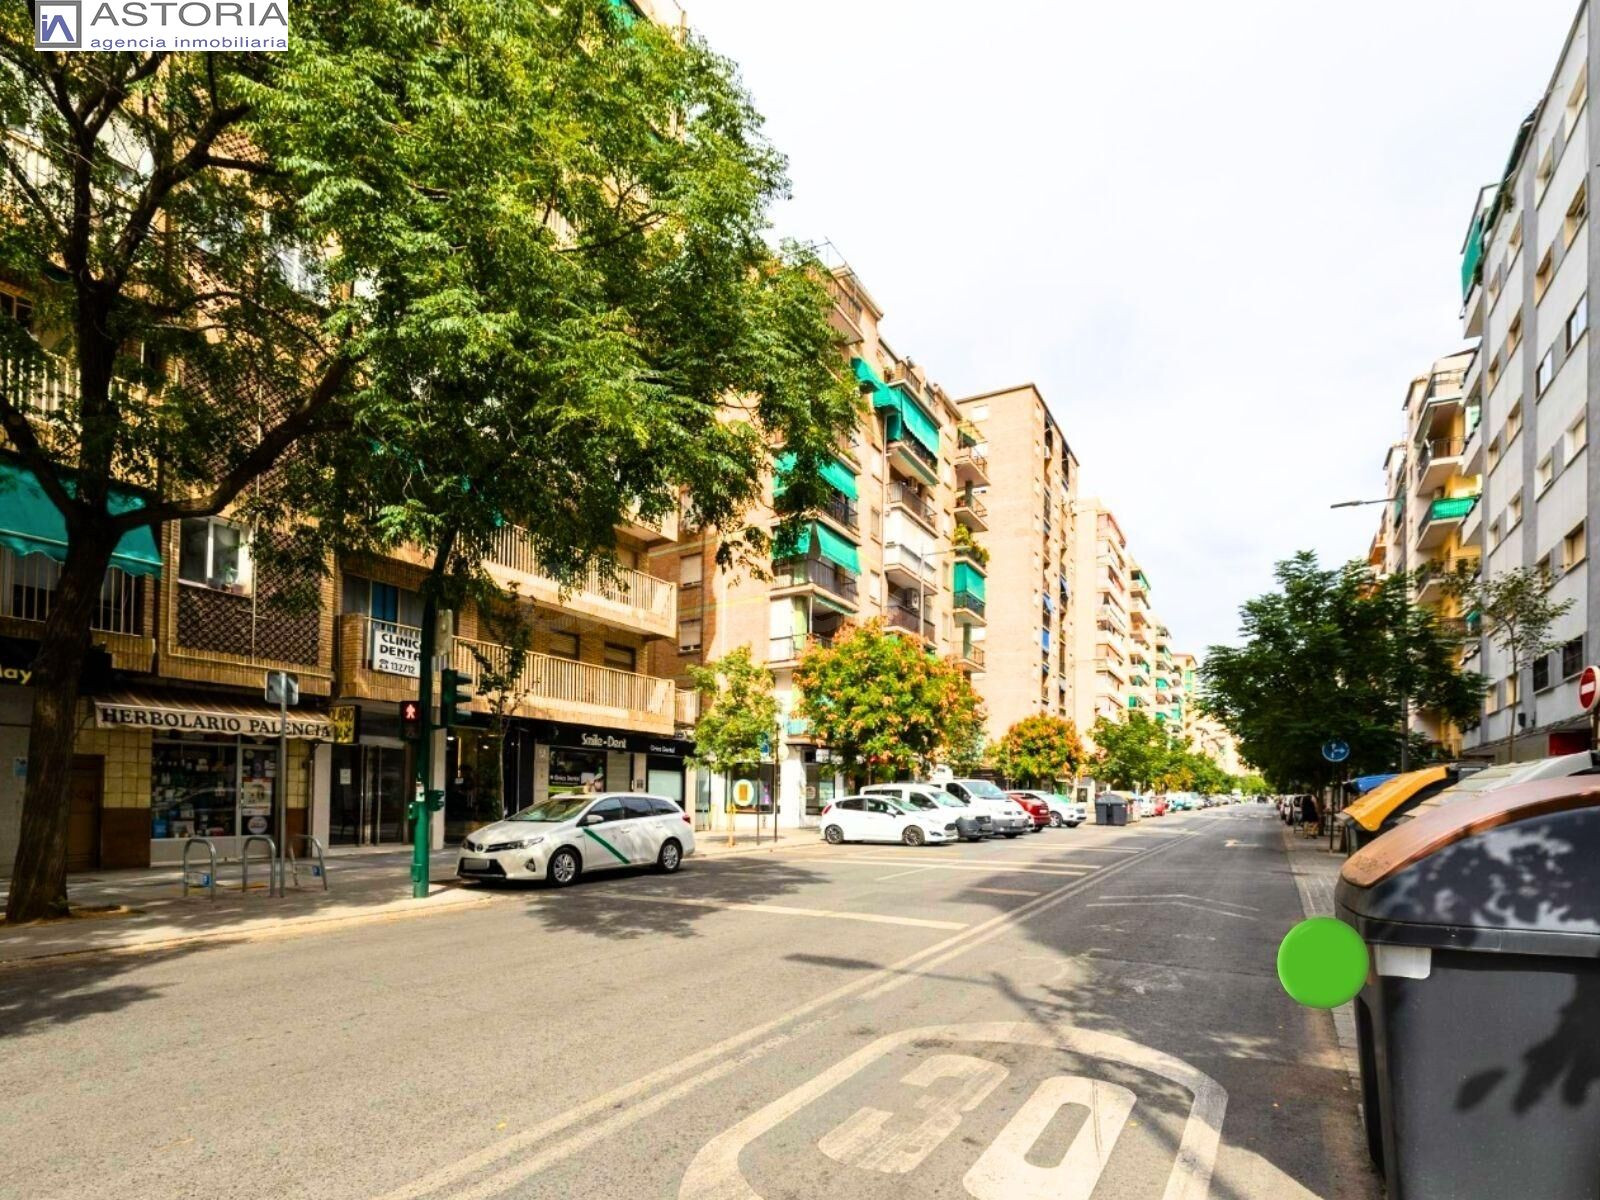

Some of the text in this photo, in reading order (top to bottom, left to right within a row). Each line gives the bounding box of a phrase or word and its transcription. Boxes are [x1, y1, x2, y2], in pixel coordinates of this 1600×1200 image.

[380, 644, 421, 661] DENTA
[381, 633, 421, 650] CLINIC
[101, 707, 330, 737] HERBOLARIO PALENCIA
[817, 1053, 1137, 1200] 30
